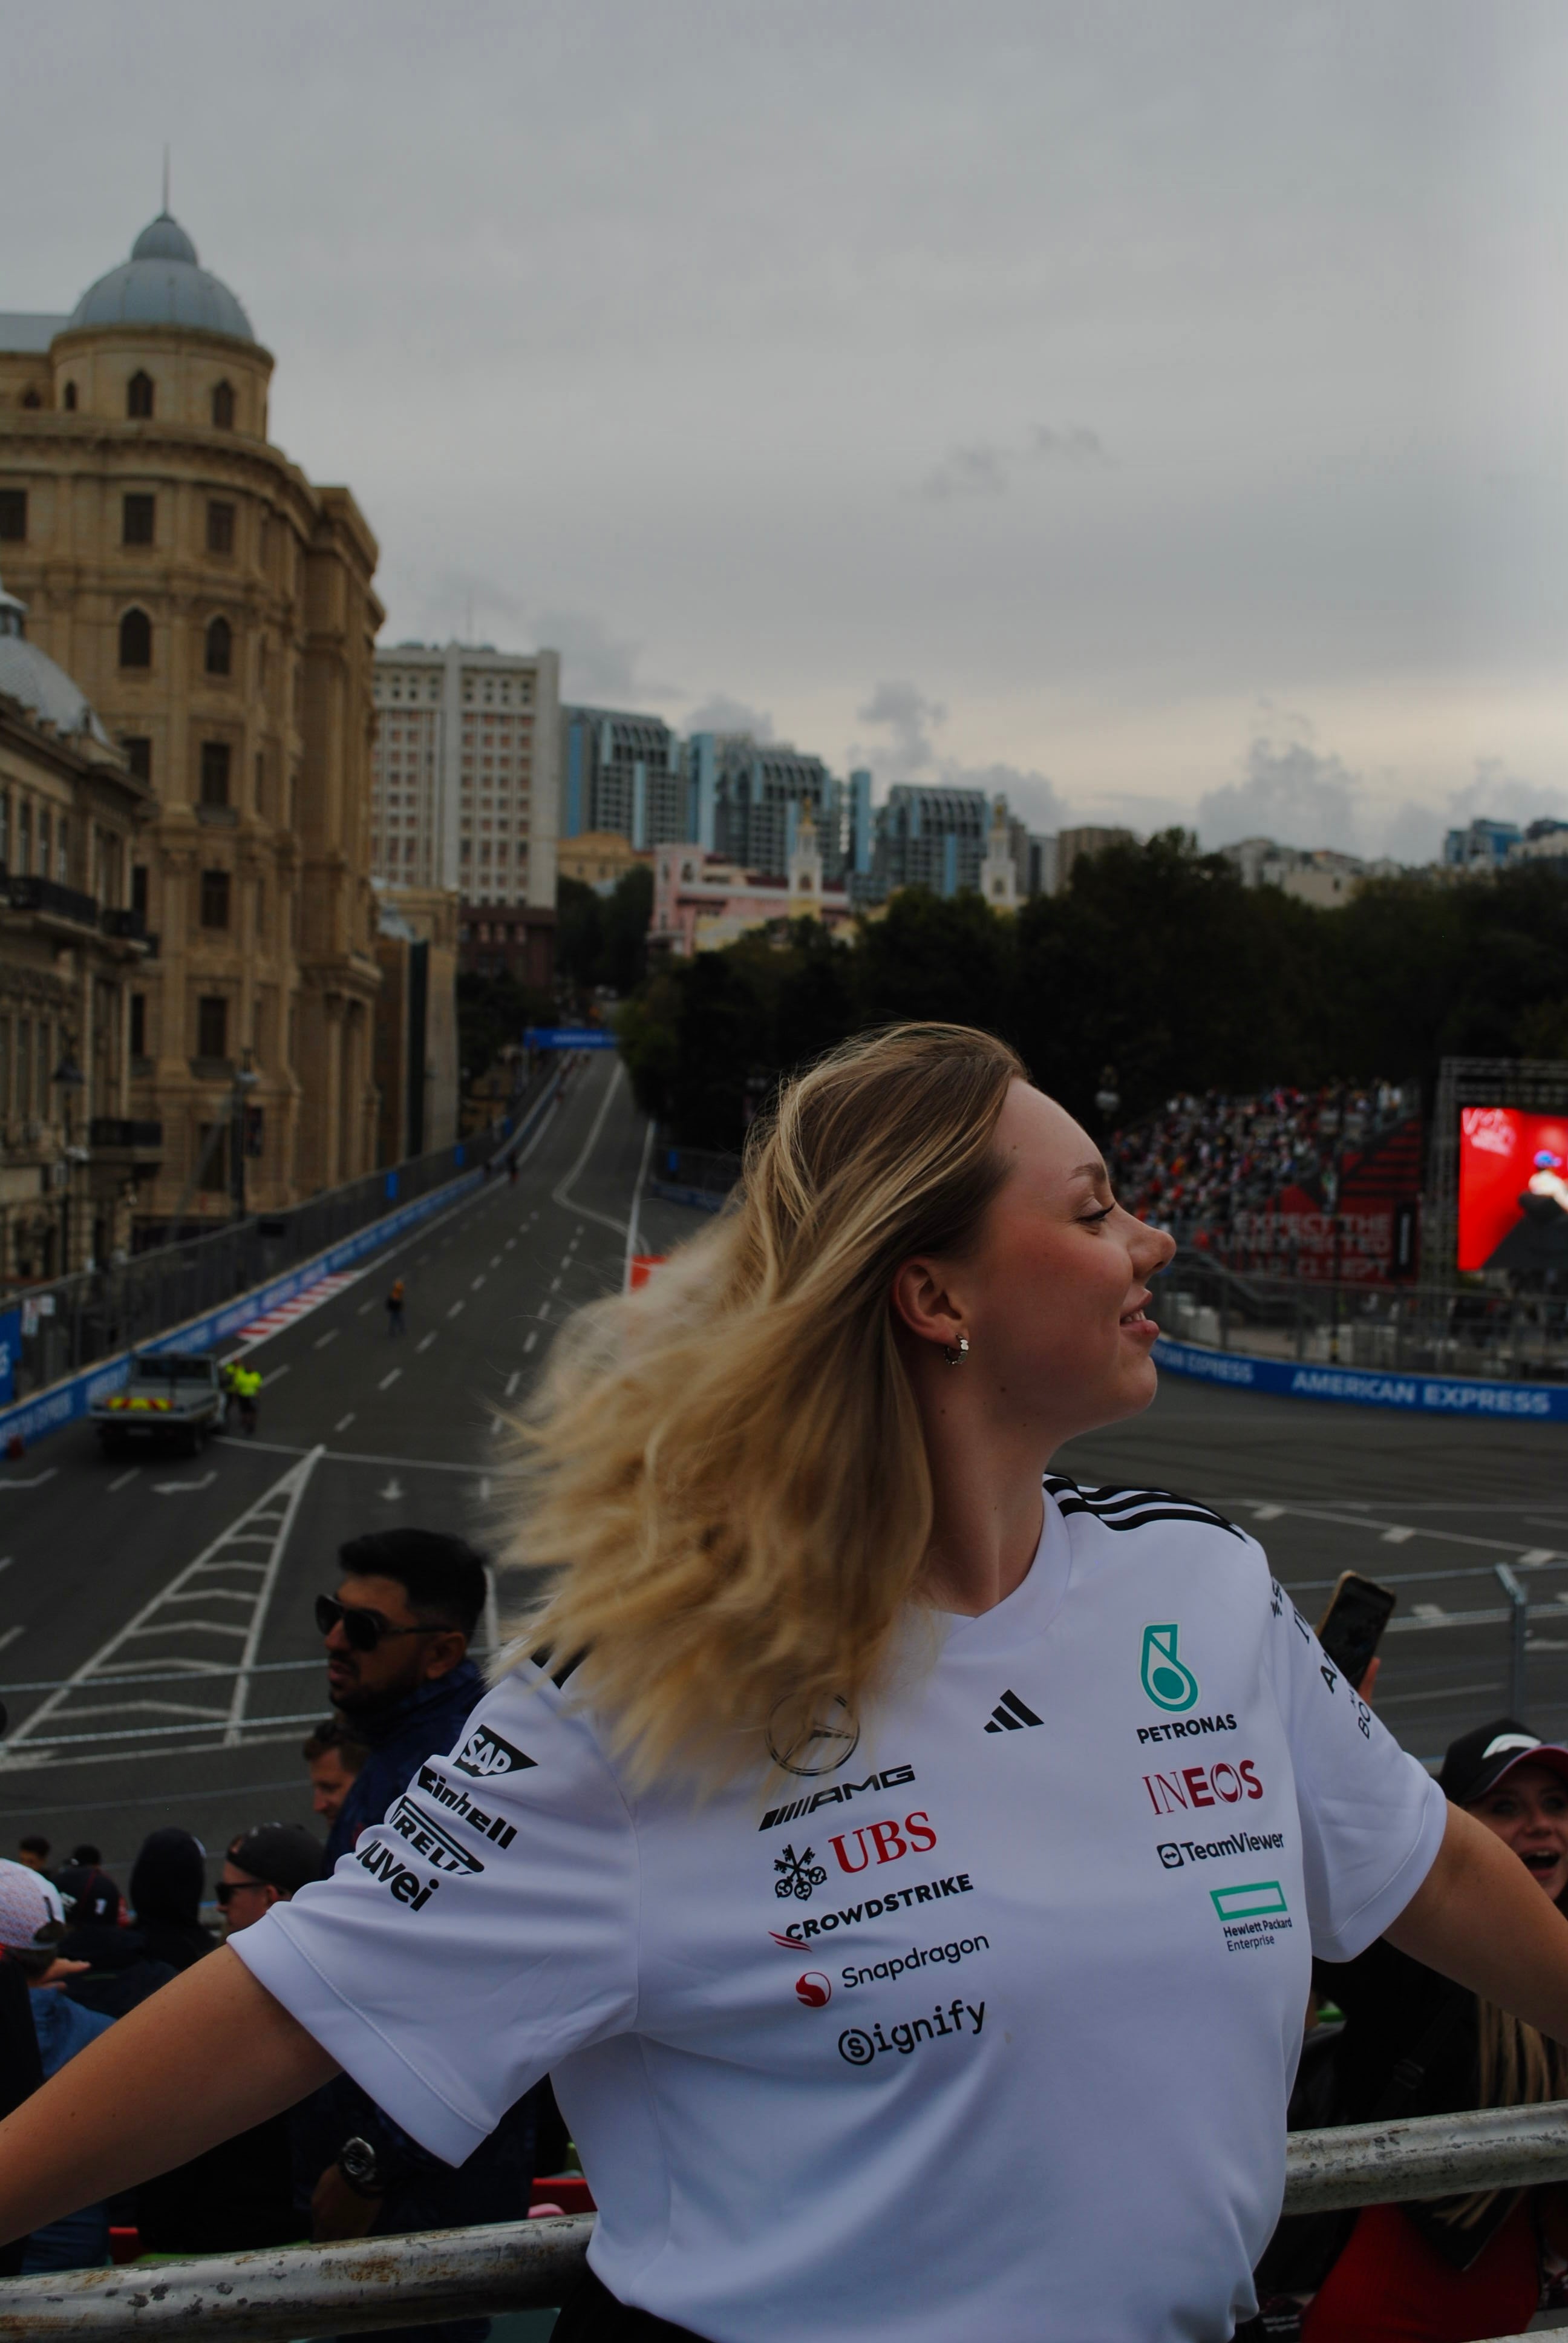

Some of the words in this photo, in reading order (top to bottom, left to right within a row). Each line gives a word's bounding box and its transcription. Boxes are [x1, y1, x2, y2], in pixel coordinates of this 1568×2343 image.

[1291, 1369, 1417, 1404] AMERICAN
[1422, 1383, 1551, 1415] EXPRESS
[1136, 1714, 1237, 1744] PETRONAS
[460, 1733, 512, 1776] SAP
[417, 1765, 518, 1850] Einhell
[808, 1764, 916, 1814] AMG
[1142, 1760, 1264, 1815] INEOS
[388, 1795, 485, 1875] PIREL
[828, 1812, 938, 1873] UBS
[1181, 1832, 1284, 1862] TeamViewer
[785, 1873, 974, 1941] CROWDSTRIKE
[1223, 1921, 1262, 1938] Hewlett
[1261, 1916, 1293, 1932] Packard
[841, 1935, 990, 1988] Snapdragon
[1226, 1935, 1275, 1952] Enterprise
